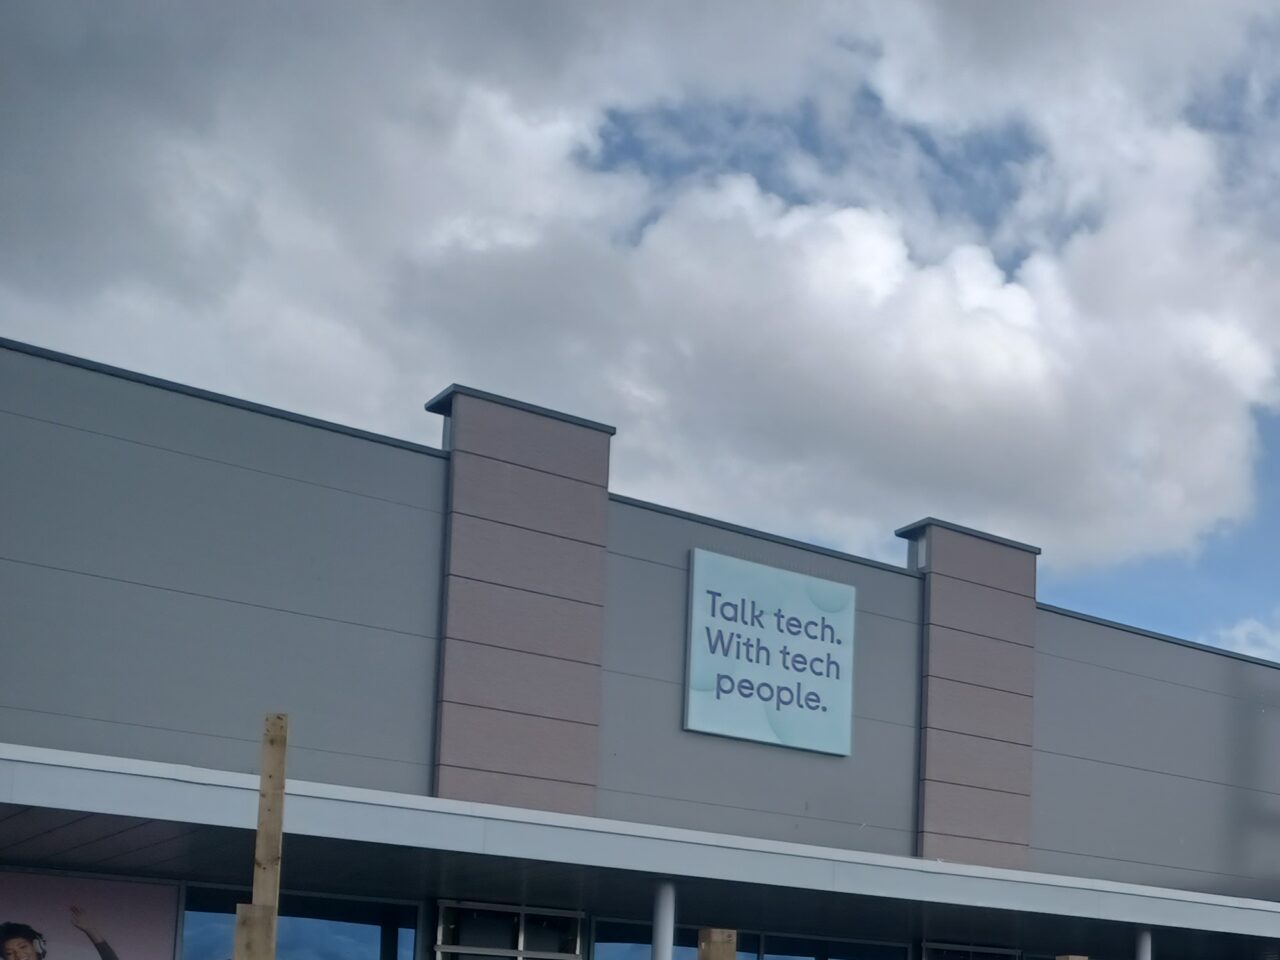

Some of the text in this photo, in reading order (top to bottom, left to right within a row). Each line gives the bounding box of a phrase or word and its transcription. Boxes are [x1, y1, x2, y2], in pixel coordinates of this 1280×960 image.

[706, 589, 843, 646] Talk tech.
[705, 626, 841, 680] With tech
[715, 673, 828, 713] people.
